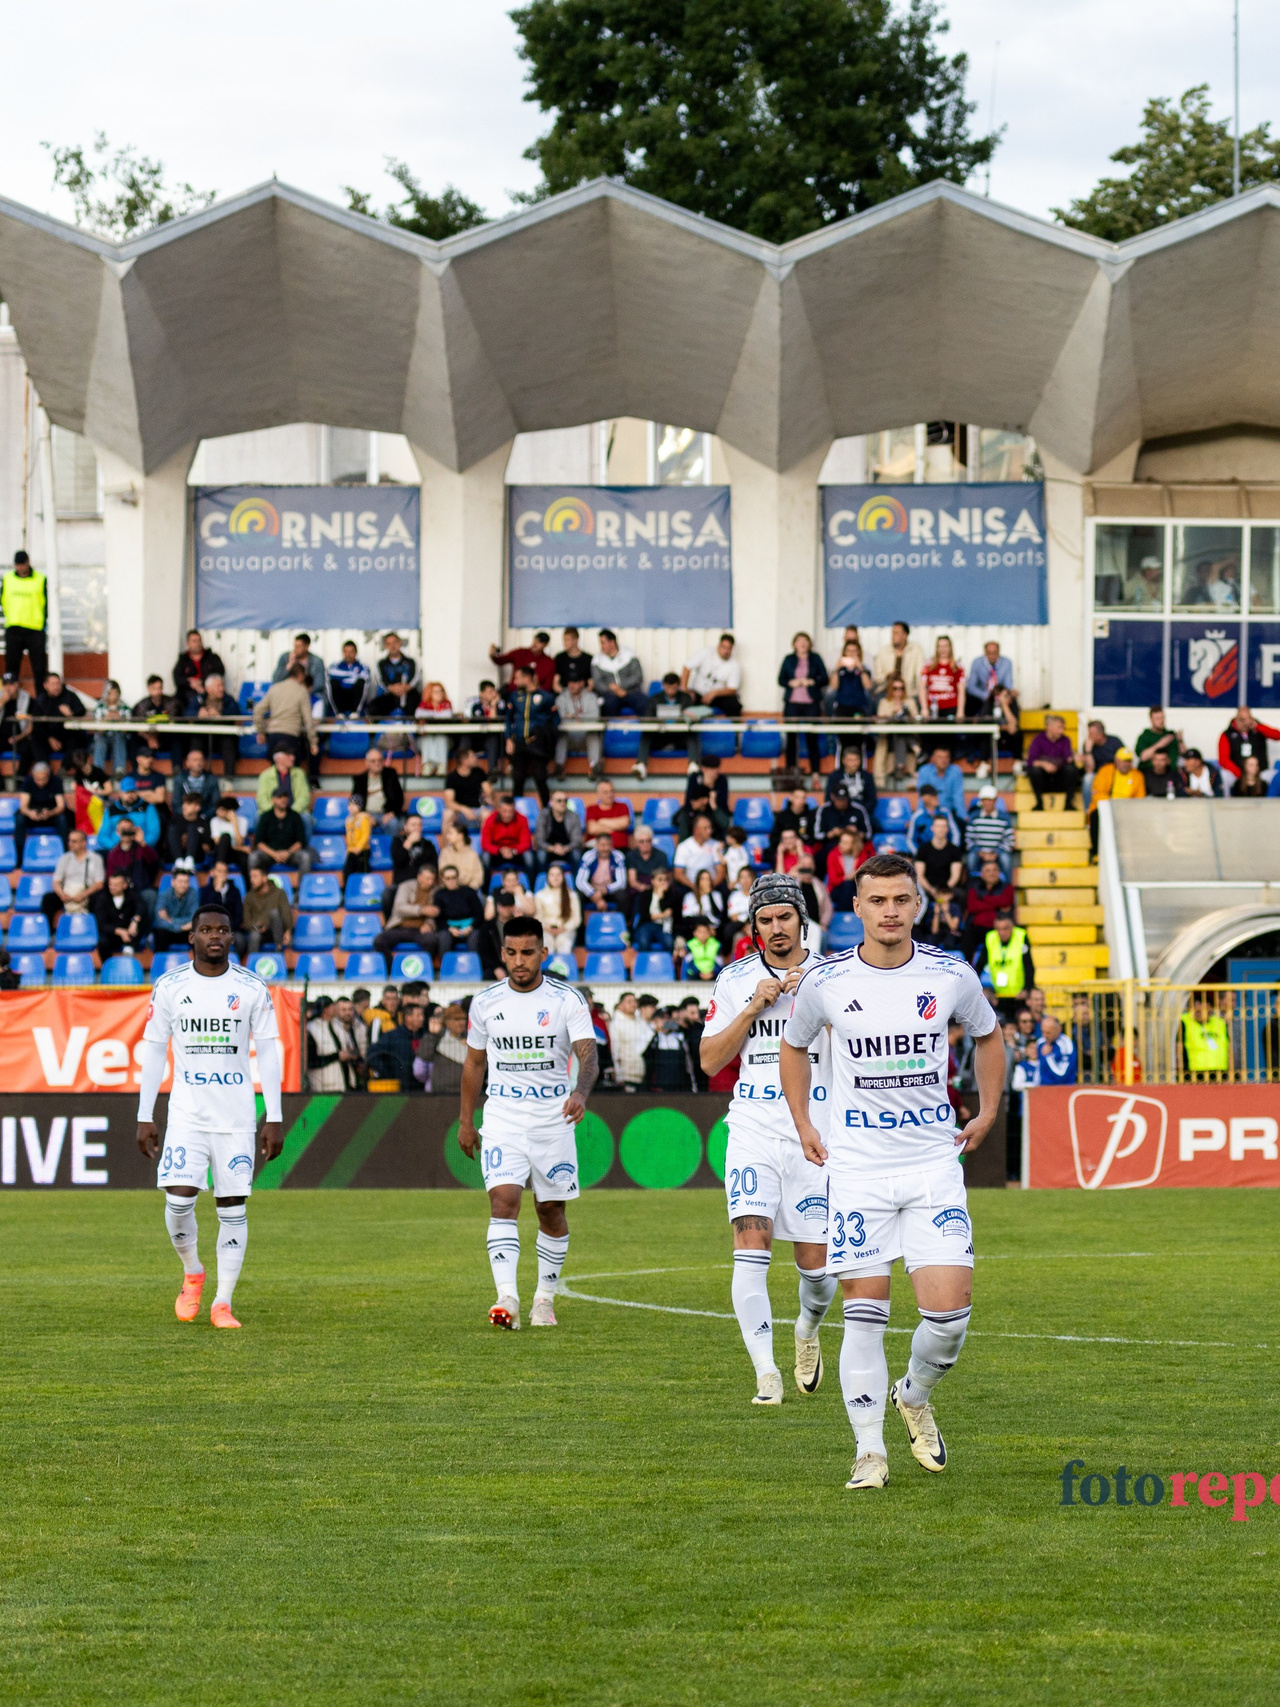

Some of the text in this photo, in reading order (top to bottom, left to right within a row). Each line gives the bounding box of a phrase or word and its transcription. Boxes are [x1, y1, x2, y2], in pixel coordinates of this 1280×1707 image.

[200, 553, 417, 574] aquapark & sports
[514, 551, 731, 573] aquapark & sports
[828, 547, 1045, 572] aquapark & sports
[180, 1018, 242, 1033] UNIBET
[748, 1019, 788, 1038] UNI
[493, 1035, 557, 1049] UNIBET
[847, 1032, 940, 1059] UNIBET
[753, 1053, 780, 1064] ÎMPREUN
[903, 1074, 924, 1087] SPRE
[924, 1074, 936, 1085] 0%
[490, 1083, 566, 1099] ELSACO
[739, 1082, 827, 1101] ELSO
[845, 1103, 951, 1130] ELSACO
[163, 1146, 187, 1170] 83
[484, 1147, 503, 1172] 10
[729, 1167, 758, 1198] 20
[745, 1199, 767, 1208] Vestra
[935, 1213, 946, 1226] FIVE
[832, 1211, 866, 1248] 33
[854, 1246, 880, 1259] Vestra
